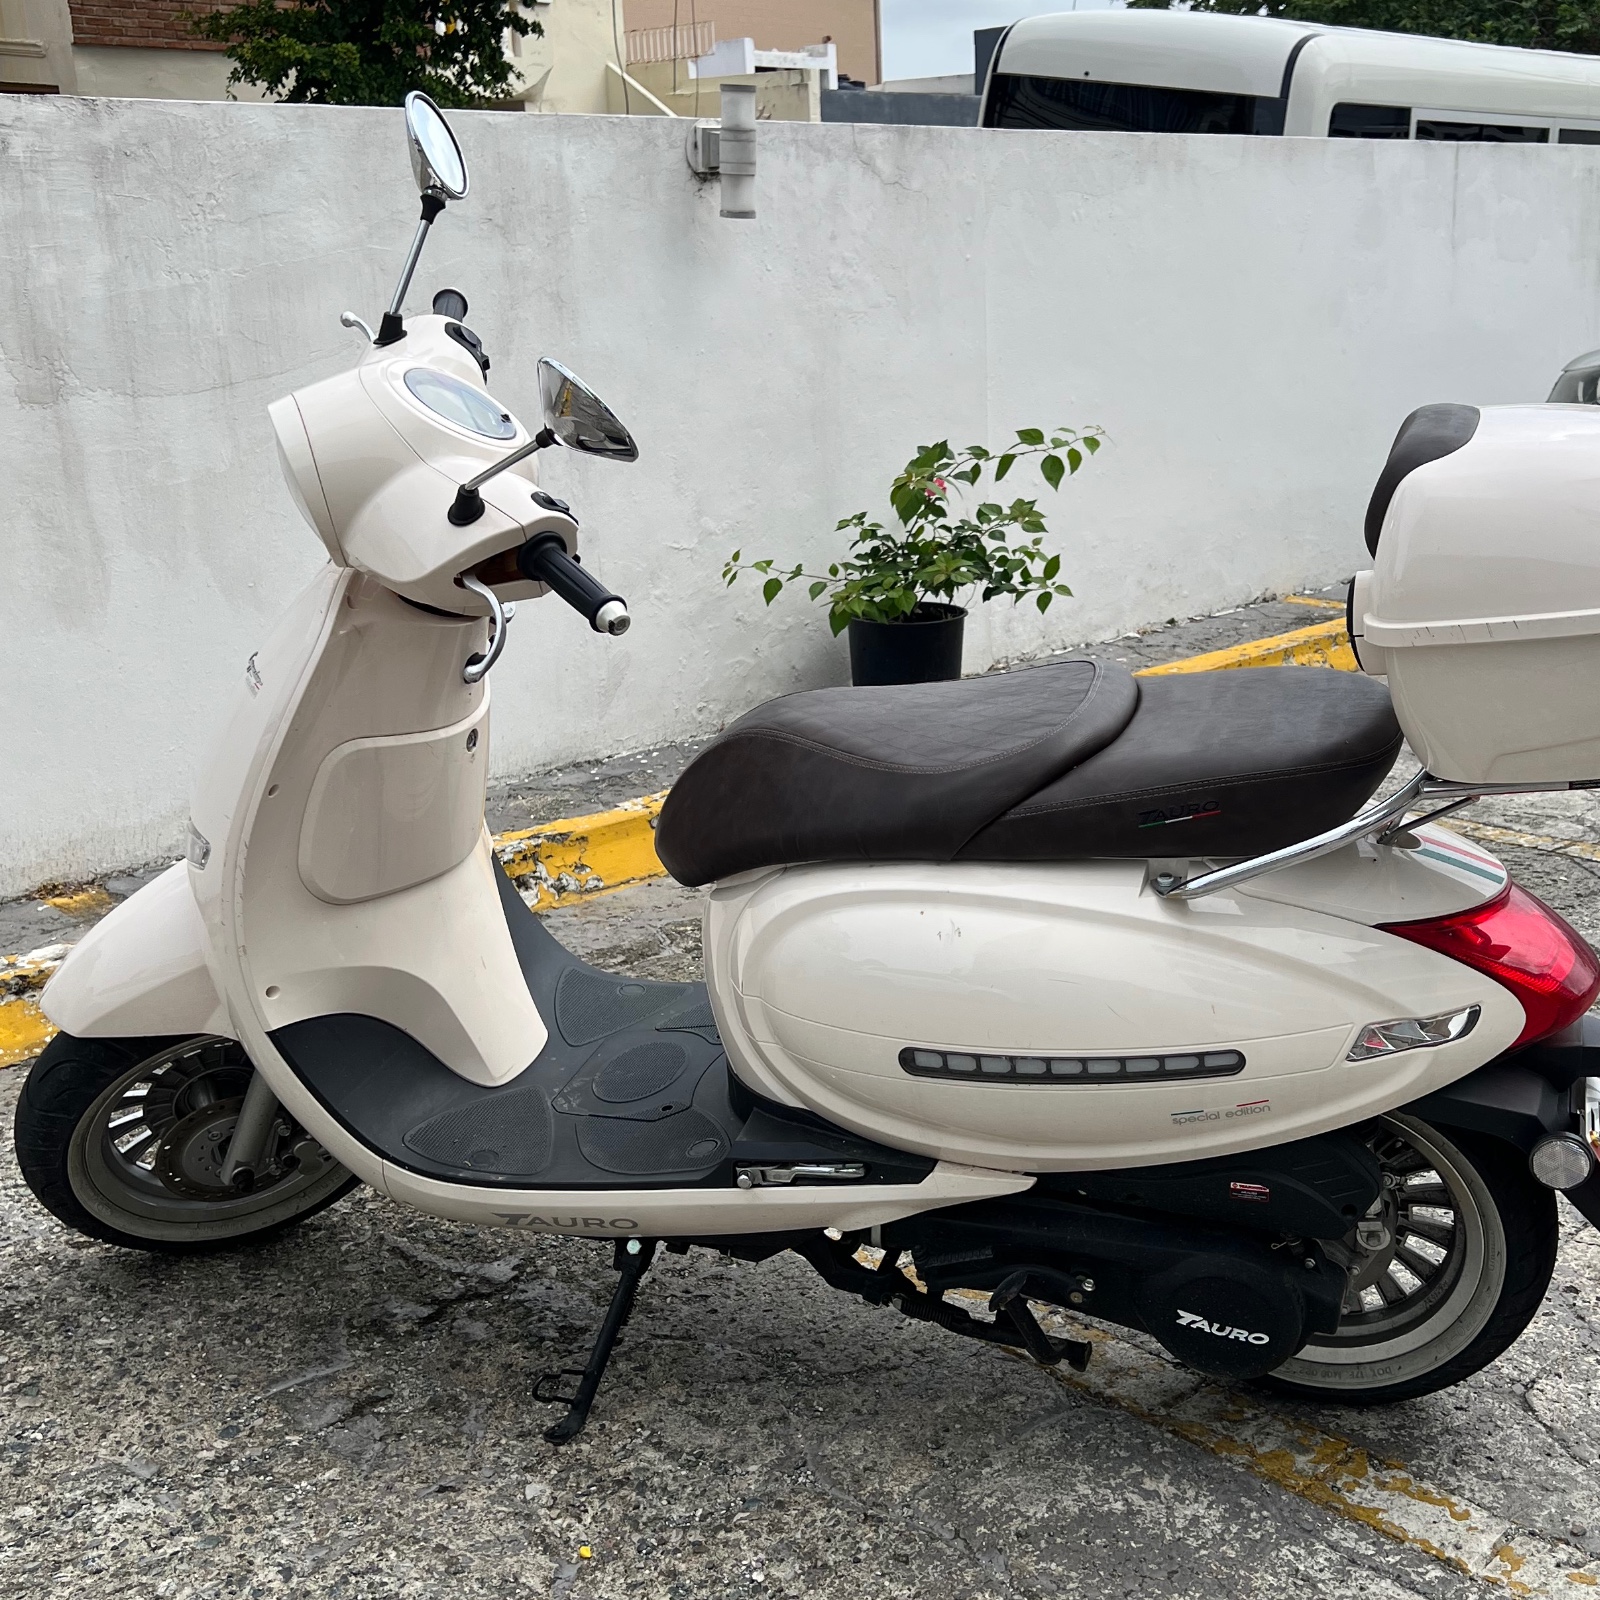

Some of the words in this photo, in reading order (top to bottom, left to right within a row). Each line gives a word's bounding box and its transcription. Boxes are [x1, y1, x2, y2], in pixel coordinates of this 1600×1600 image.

[1138, 801, 1219, 822] TAURO
[1172, 1111, 1220, 1126] special
[1225, 1104, 1271, 1118] edition
[491, 1212, 639, 1229] TAURO
[1176, 1309, 1270, 1345] TAURO
